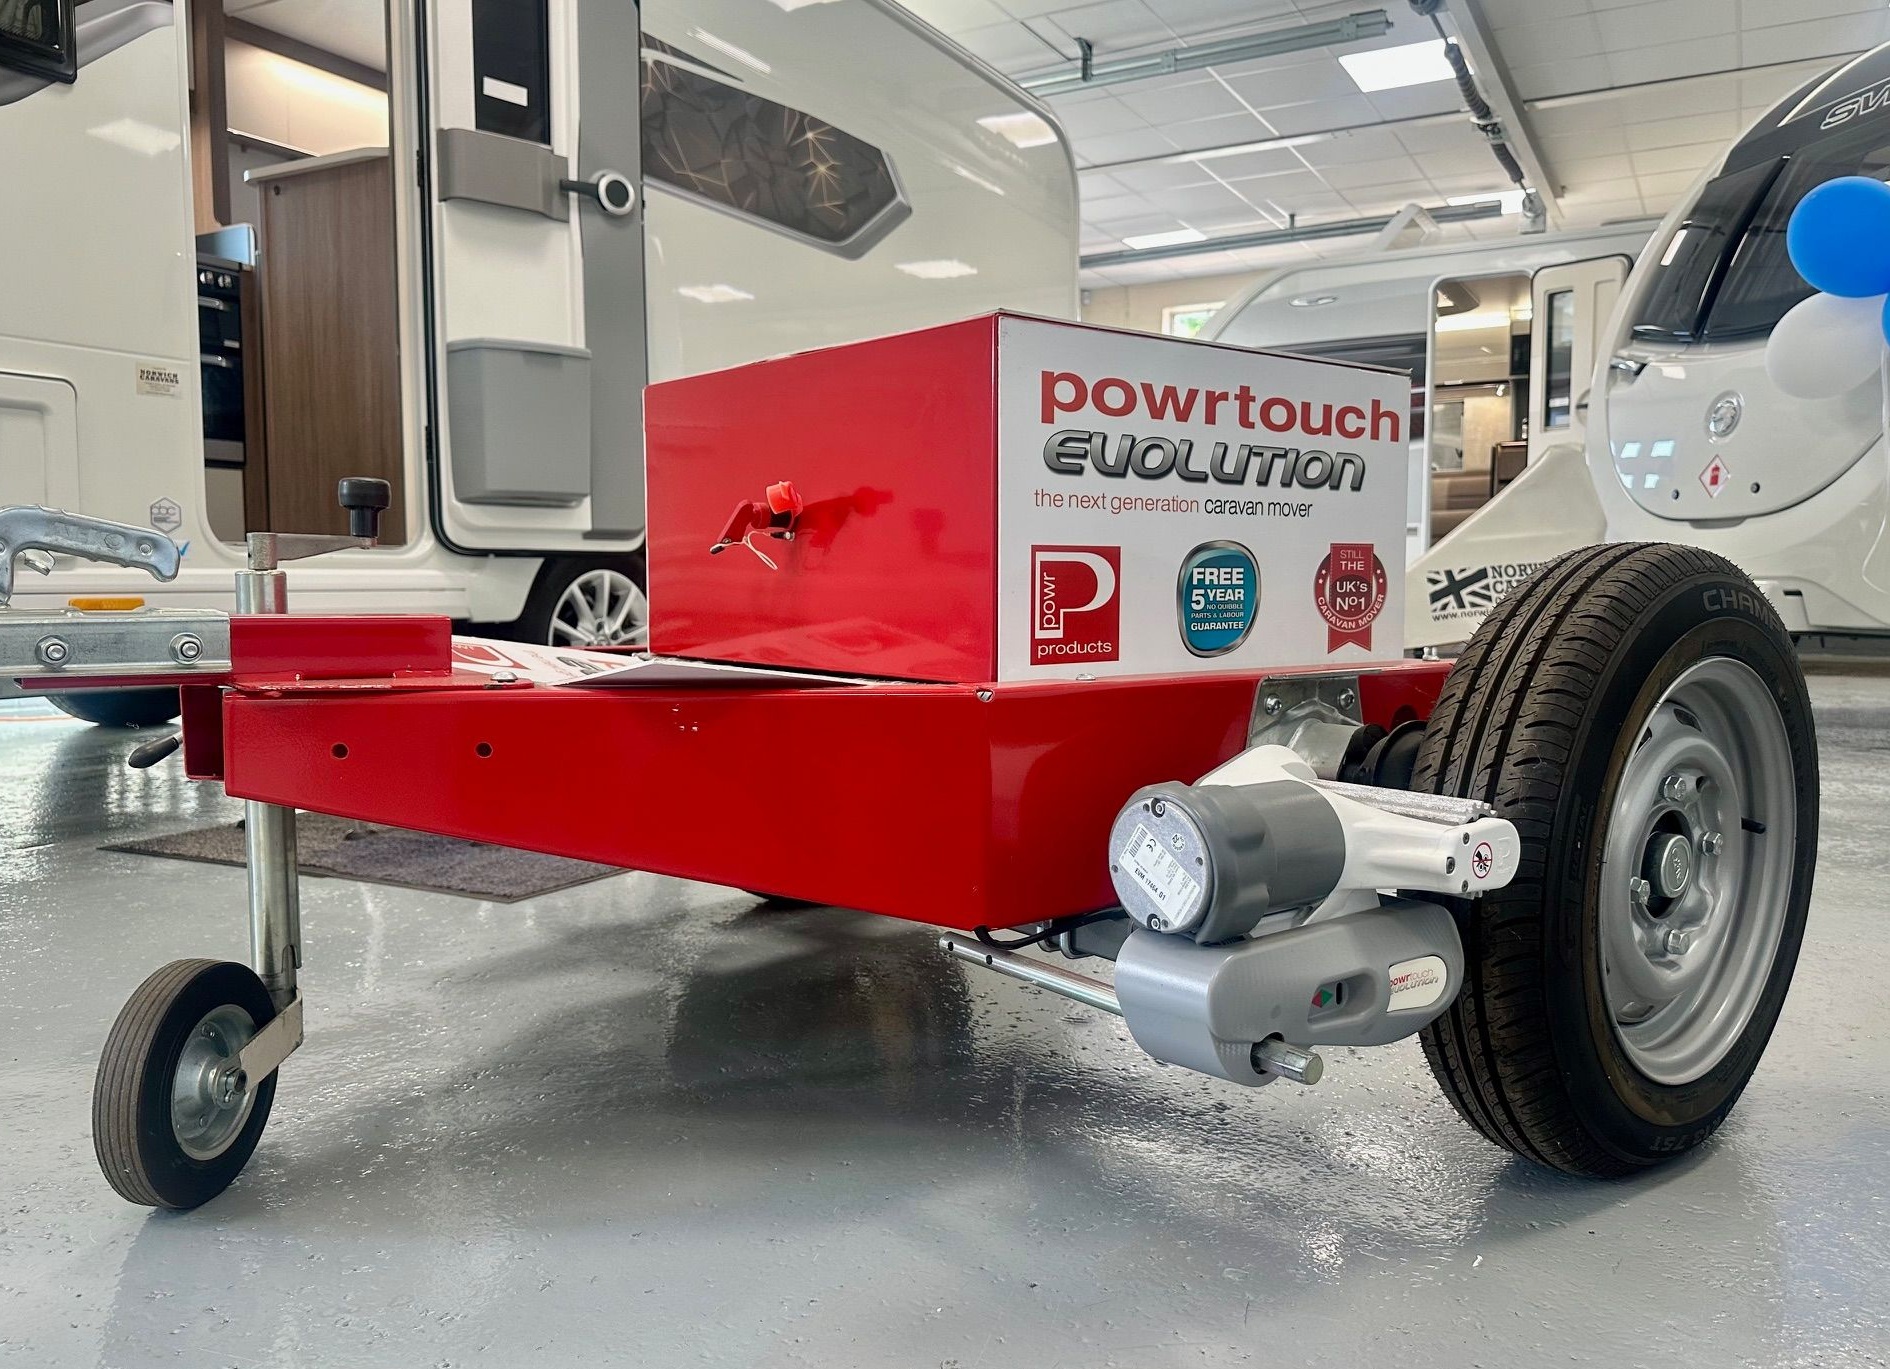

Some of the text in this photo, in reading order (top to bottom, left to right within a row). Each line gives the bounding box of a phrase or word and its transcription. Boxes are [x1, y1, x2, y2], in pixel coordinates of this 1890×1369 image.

[1041, 370, 1399, 443] powrtouch
[1034, 489, 1314, 517] the next generation caravan mover
[1340, 549, 1364, 559] STILL
[1340, 561, 1365, 571] THE
[1192, 567, 1244, 585] FREE
[1336, 581, 1368, 593] UK's
[1043, 571, 1059, 628] powr
[1191, 588, 1245, 611] 5 YEAR
[1318, 593, 1385, 629] CARAVAN MOVER
[1191, 621, 1245, 631] GUARANTEE
[1038, 640, 1112, 659] products
